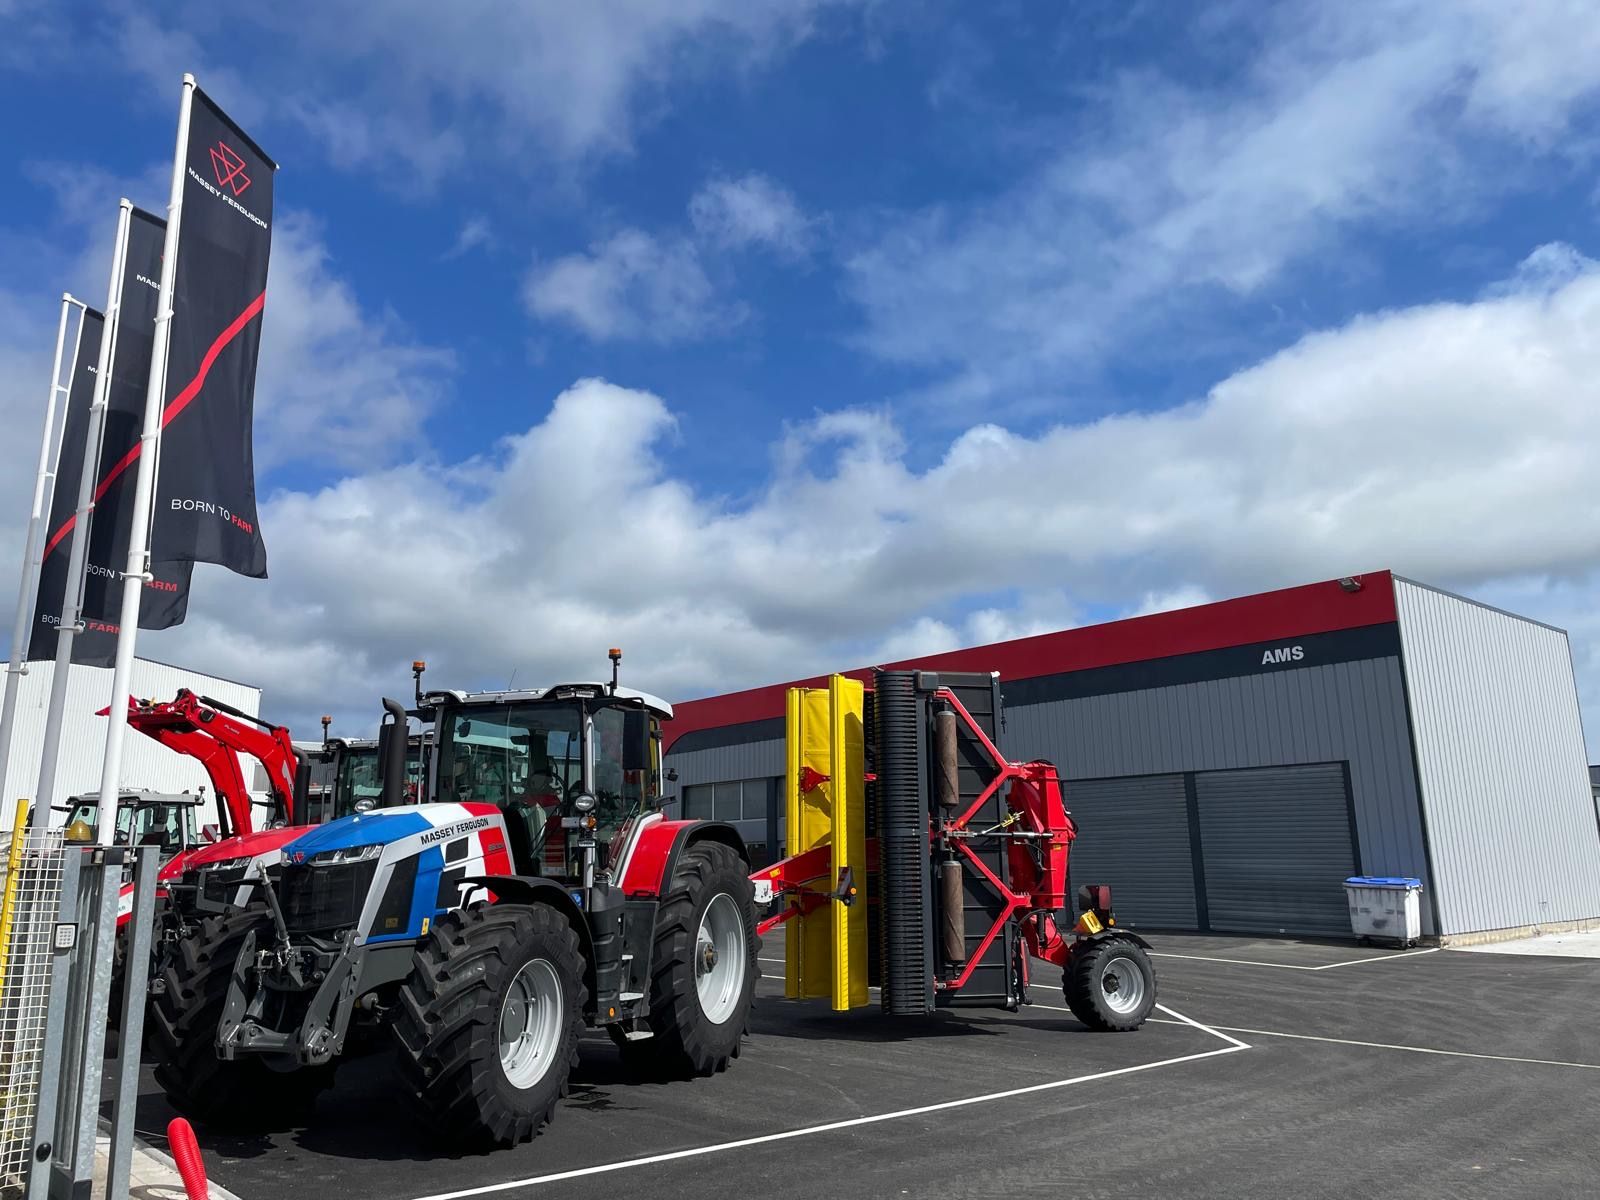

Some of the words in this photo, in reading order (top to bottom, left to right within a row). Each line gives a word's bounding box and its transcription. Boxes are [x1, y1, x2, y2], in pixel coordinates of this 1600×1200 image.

[188, 166, 221, 197] MASSEY
[222, 194, 268, 229] FERGUSON
[136, 274, 161, 291] MASS
[171, 499, 215, 514] BORN
[217, 505, 230, 521] TO
[41, 614, 61, 625] BOR
[1261, 645, 1305, 665] AMS
[421, 826, 455, 844] MASSEY
[456, 818, 489, 833] FERGUSON
